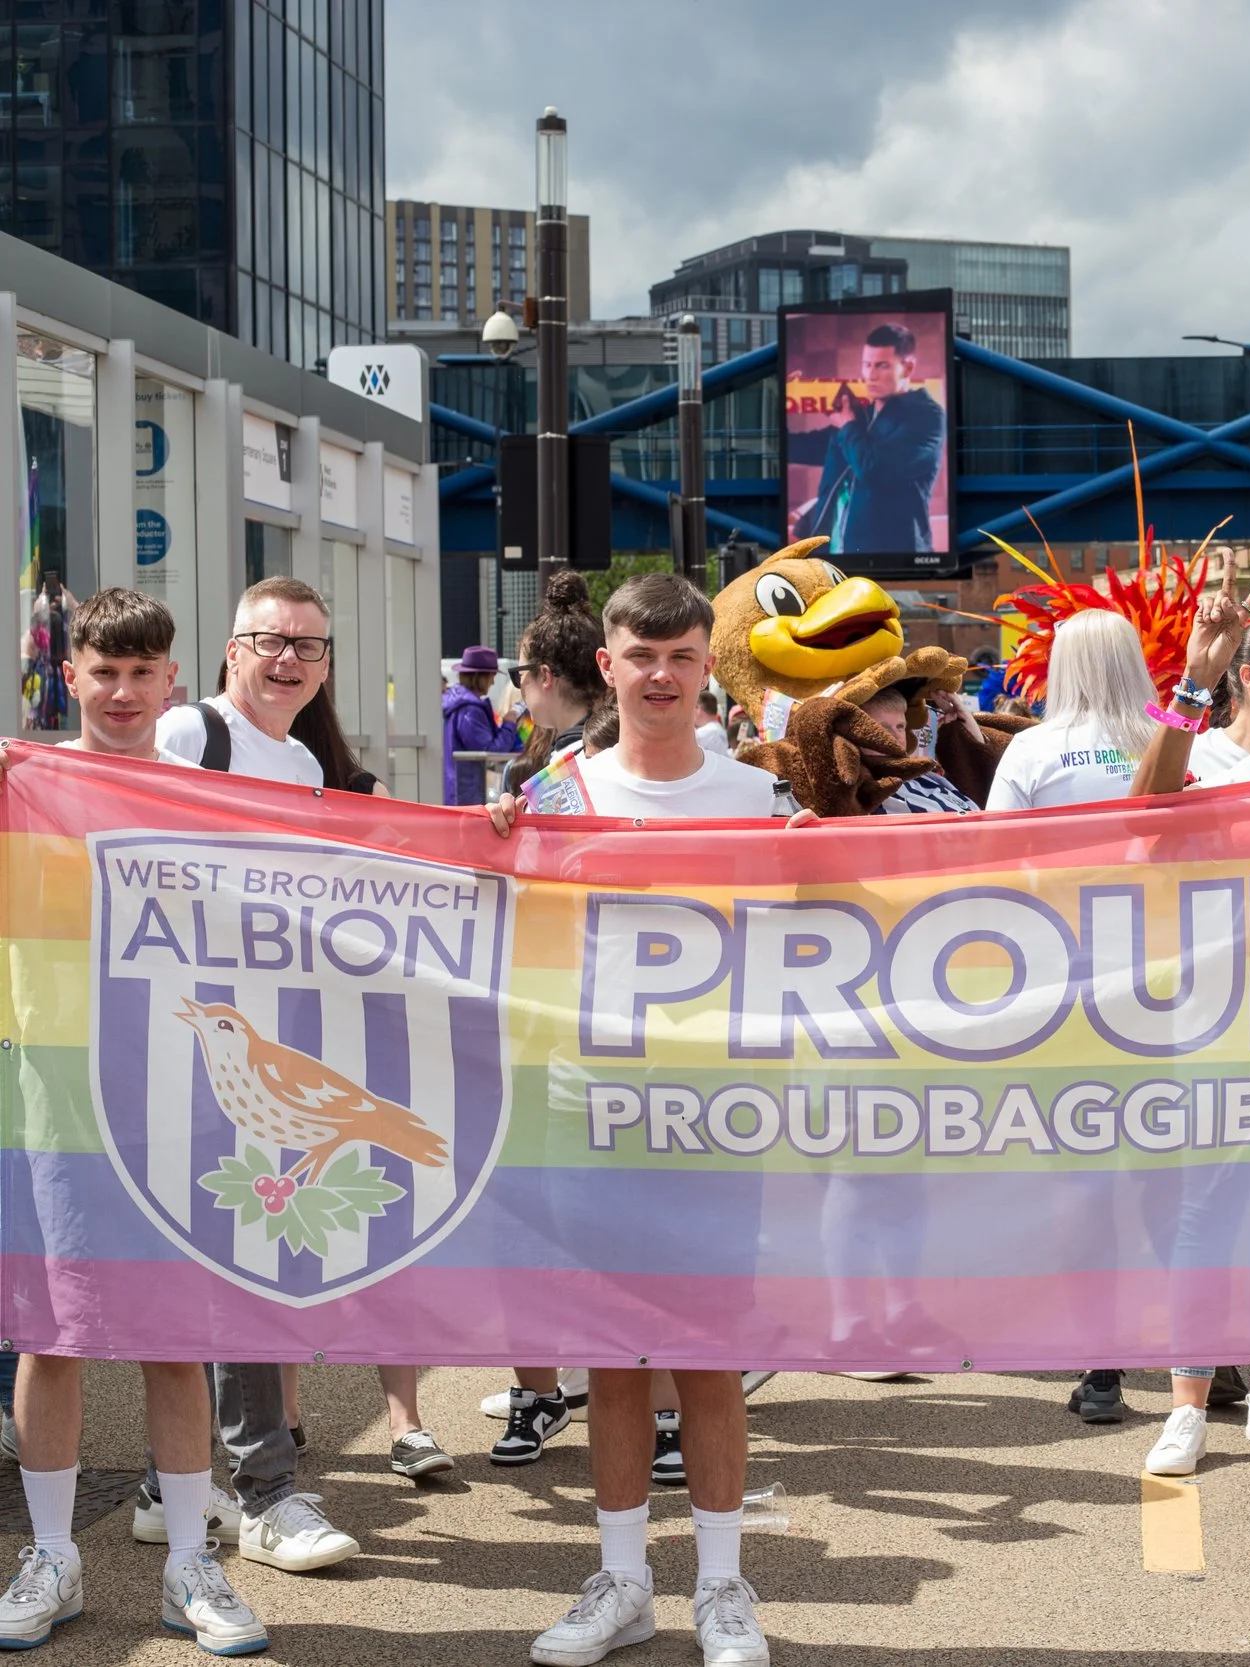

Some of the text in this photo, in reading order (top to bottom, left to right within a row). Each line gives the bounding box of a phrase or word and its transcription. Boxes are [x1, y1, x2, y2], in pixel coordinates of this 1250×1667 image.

[135, 391, 187, 403] buy tickets
[282, 452, 287, 472] 1
[1060, 750, 1091, 768] WEST
[1105, 764, 1136, 774] FOOTBAL
[562, 781, 582, 814] ALBION
[116, 858, 480, 911] WEST BROMWICH
[120, 897, 476, 980] ALBION
